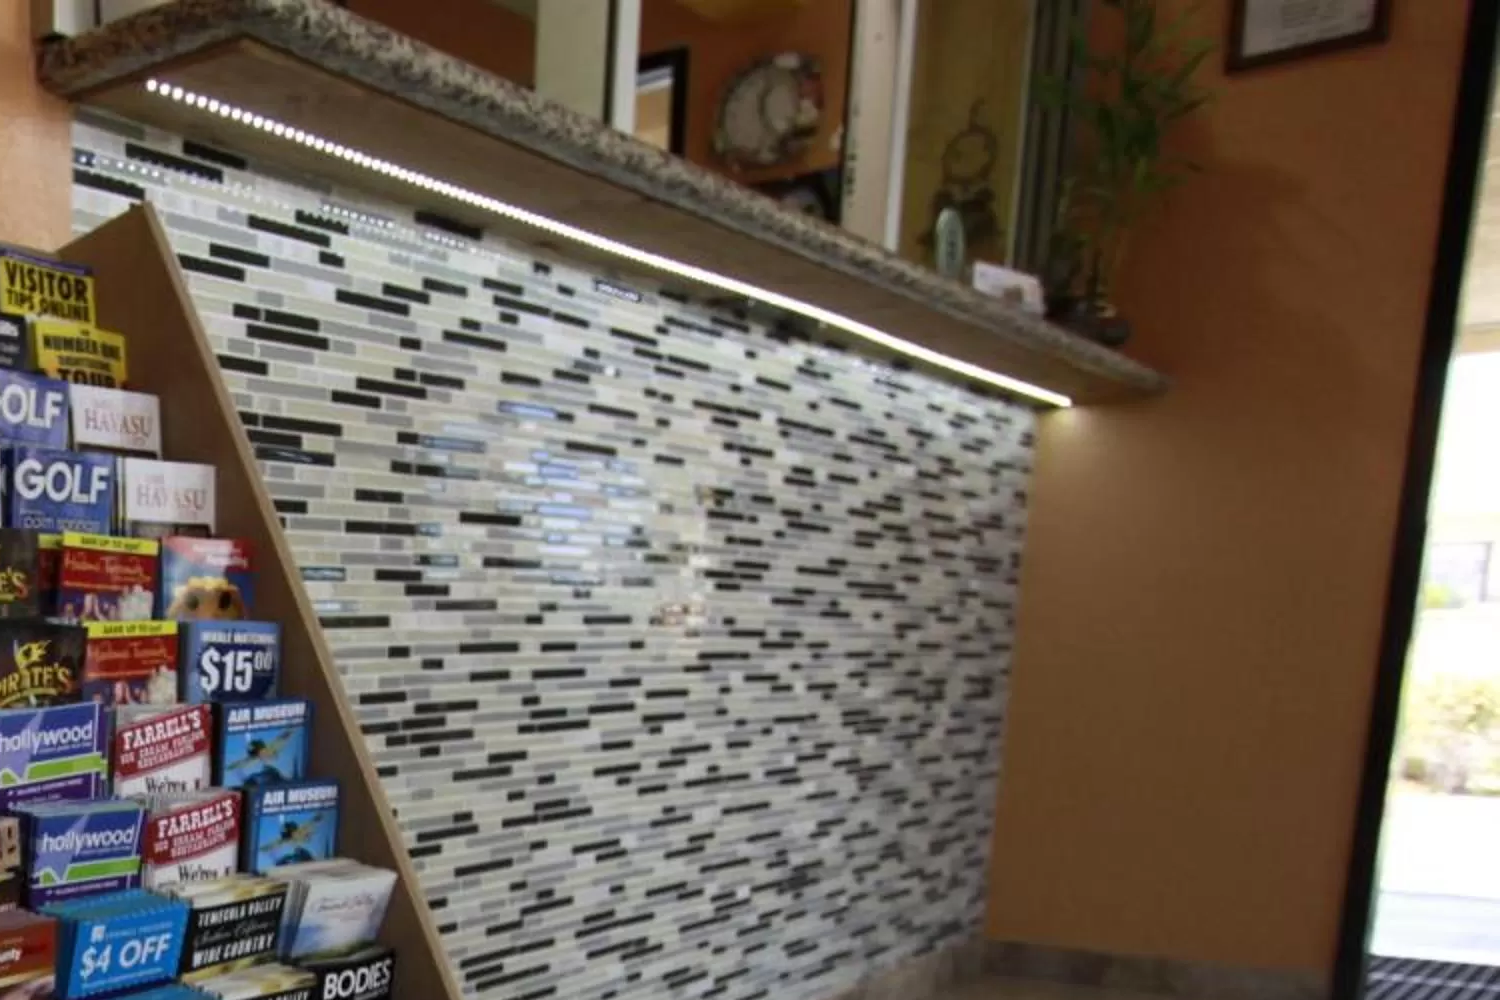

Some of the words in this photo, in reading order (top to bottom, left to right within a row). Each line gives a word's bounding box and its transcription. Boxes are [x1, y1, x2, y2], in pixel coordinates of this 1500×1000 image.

[4, 262, 88, 304] VISITOR
[6, 288, 35, 310] TIPS
[37, 297, 90, 322] ONLINE
[85, 407, 153, 438] HAVASU
[14, 458, 109, 504] GOLF
[201, 646, 253, 693] $15
[122, 708, 202, 751] FARRELL'S
[228, 707, 251, 724] AIR
[253, 702, 306, 720] MUSEUM
[263, 789, 285, 806] AIR
[287, 785, 338, 801] MUSEUM
[157, 798, 234, 838] FARRELL'S
[42, 824, 135, 857] hollywood
[80, 945, 112, 980] $4
[118, 931, 172, 970] OFF
[223, 932, 275, 964] COUNTRY
[322, 956, 394, 1000] BODIES
